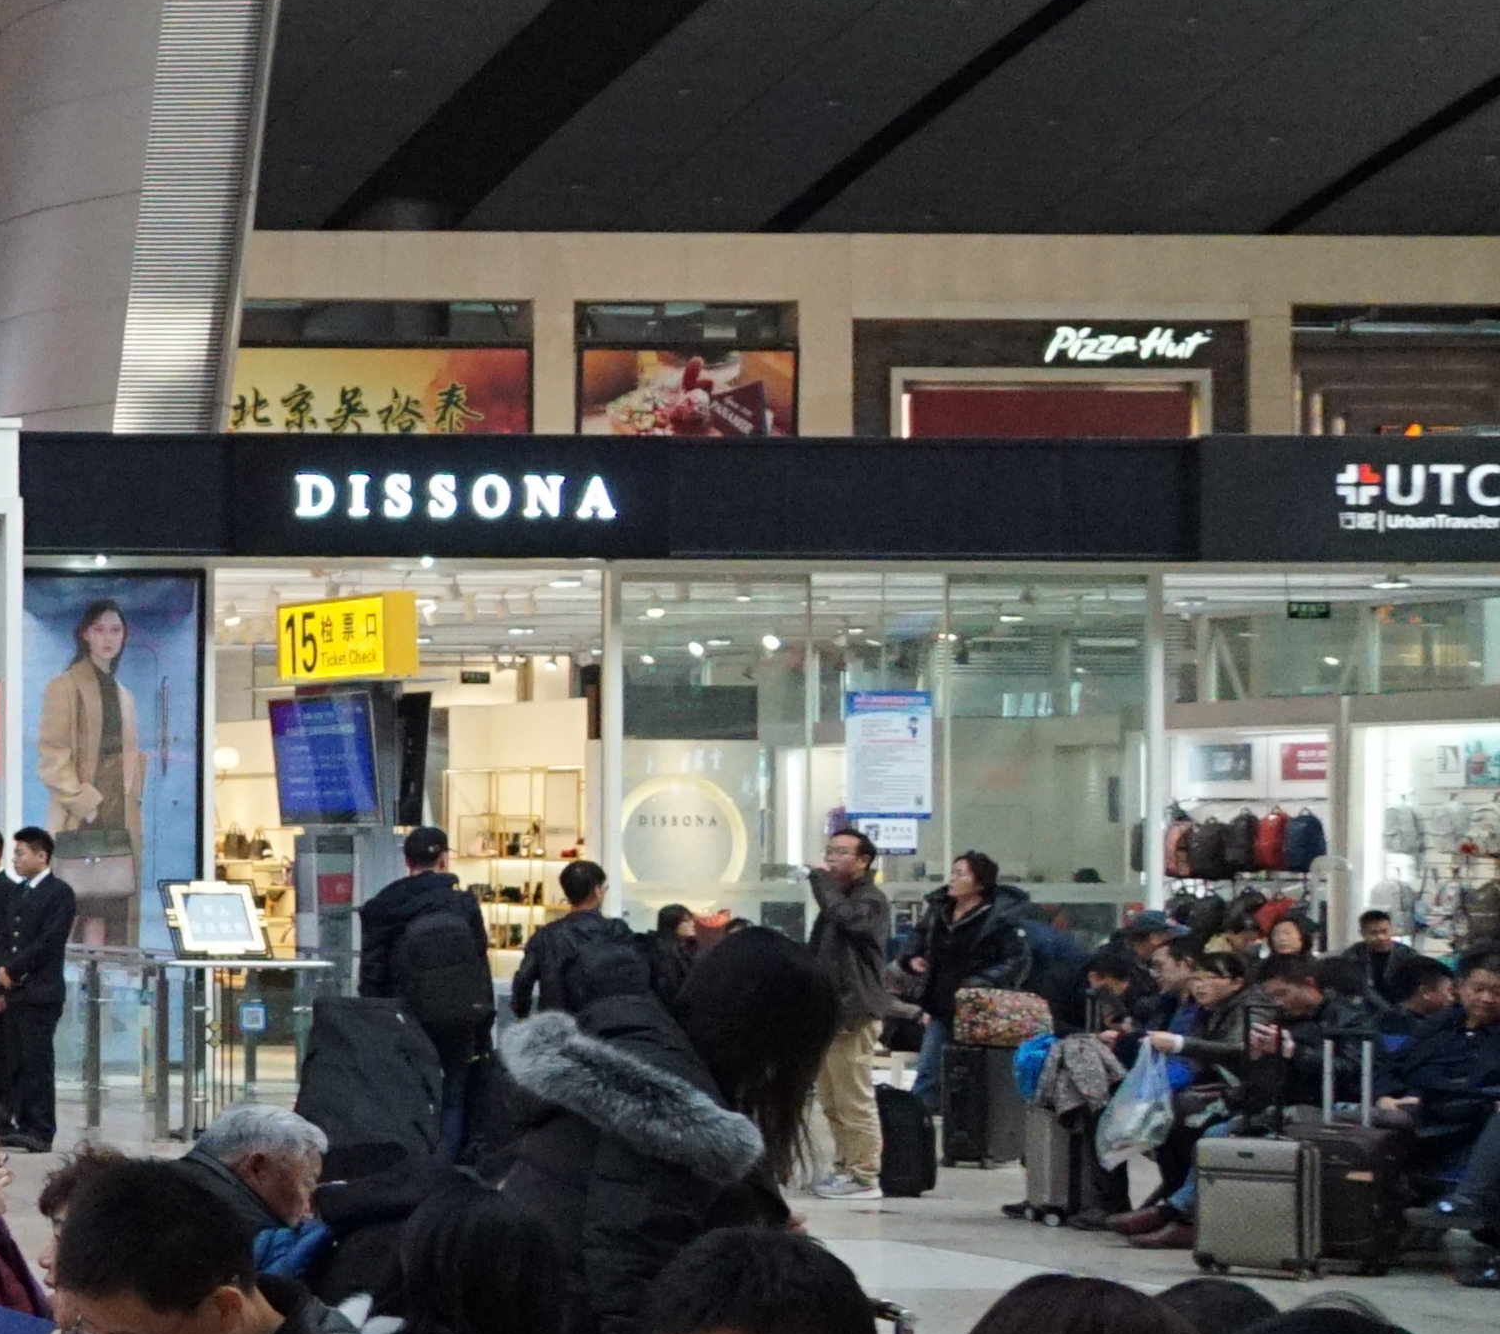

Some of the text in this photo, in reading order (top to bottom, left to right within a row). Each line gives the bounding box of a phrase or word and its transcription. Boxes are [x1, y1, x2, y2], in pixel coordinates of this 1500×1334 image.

[1044, 326, 1208, 363] Pizza Hut
[294, 472, 617, 519] DISSONA
[286, 611, 377, 675] 15 检票口
[321, 647, 378, 667] Ticket Check
[638, 814, 718, 827] DISSONA
